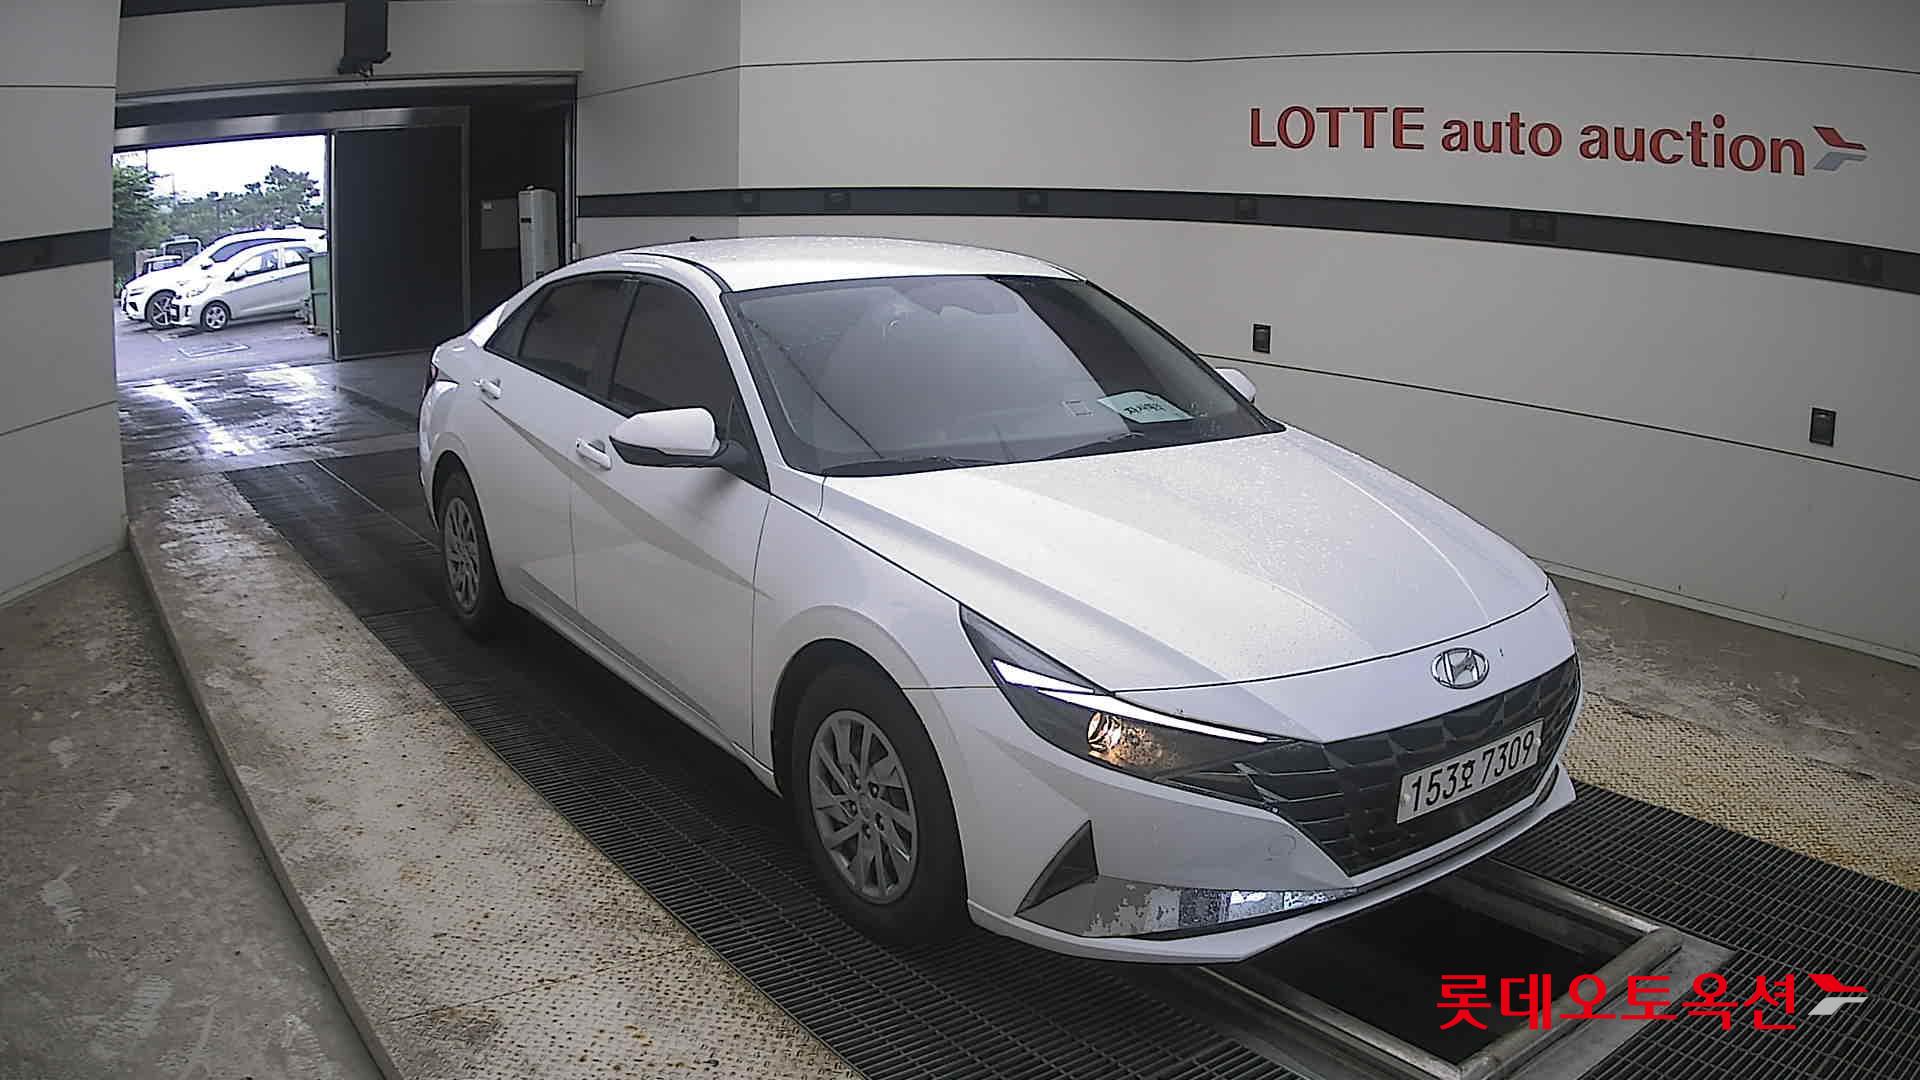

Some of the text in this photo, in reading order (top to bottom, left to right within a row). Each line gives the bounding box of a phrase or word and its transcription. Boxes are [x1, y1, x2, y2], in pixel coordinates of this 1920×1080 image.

[1250, 106, 1806, 176] LOTTE auto auction
[1412, 731, 1534, 812] 153호 7309
